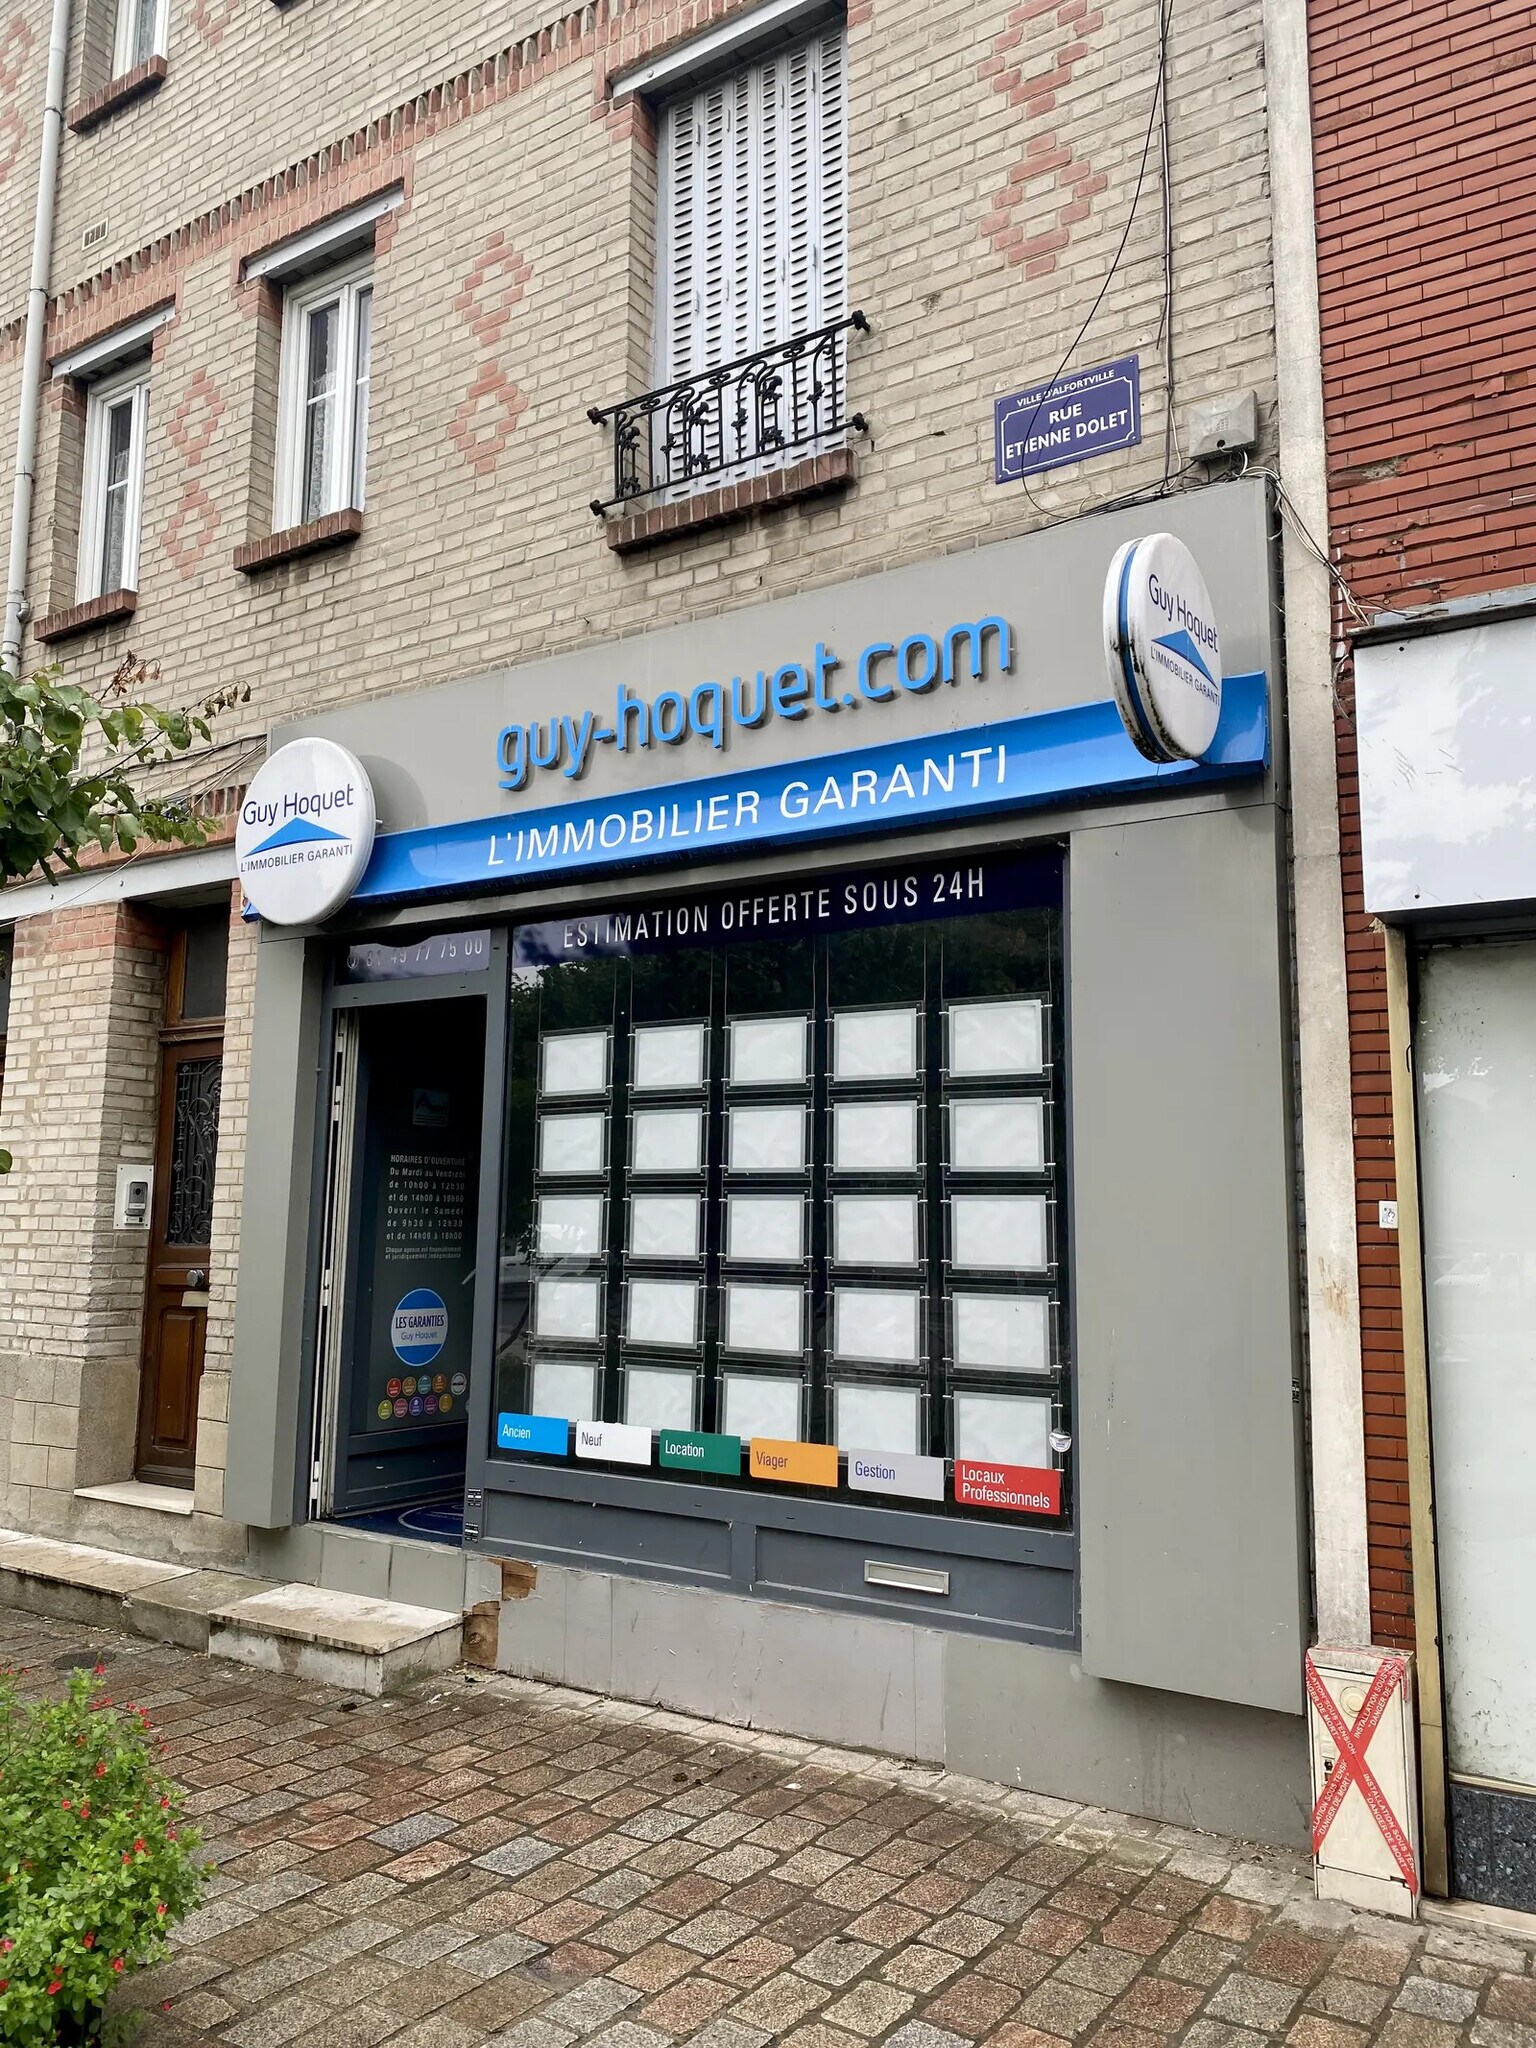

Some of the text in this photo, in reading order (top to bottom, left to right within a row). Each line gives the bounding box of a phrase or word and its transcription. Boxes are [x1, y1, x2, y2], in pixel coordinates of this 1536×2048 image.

[1017, 369, 1115, 407] VILLE D'ALFORTVILLE
[1049, 403, 1082, 424] RUE
[1005, 409, 1128, 459] ETIENNE DOLET
[1148, 573, 1219, 654] Guy Hoquet
[1150, 646, 1220, 706] L'IMMOBILIER GARANTI
[496, 614, 1011, 791] guy-hoquet.com
[243, 783, 354, 827] Guy Hoquet
[487, 744, 1008, 867] L'IMMOBILIER GARANTI
[240, 844, 353, 873] L'IMMOBILIER GARANTI
[563, 867, 985, 949] ESTIMATION OFFERTE SOUS 24H
[440, 941, 457, 959] 75
[464, 938, 483, 956] 00
[390, 1154, 423, 1165] HORAIRES
[390, 1167, 400, 1176] Du
[402, 1168, 423, 1177] Mardi
[389, 1180, 399, 1189] de
[404, 1181, 429, 1190] 10h00
[388, 1194, 396, 1202] et
[399, 1193, 408, 1202] de
[411, 1194, 433, 1203] 14h00
[387, 1206, 417, 1215] Ouvert
[434, 1206, 464, 1215] Samedi
[386, 1219, 398, 1228] de
[402, 1219, 424, 1228] 9h30
[386, 1232, 394, 1241] et
[396, 1232, 406, 1241] de
[409, 1232, 431, 1241] 14h00
[395, 1314, 445, 1329] LES GARANTIES
[400, 1330, 438, 1342] Guy Hoquet
[502, 1423, 531, 1440] Ancien
[581, 1431, 603, 1447] Neuf
[665, 1439, 705, 1459] Location
[756, 1451, 788, 1469] Viager
[854, 1461, 896, 1481] Gestion
[962, 1467, 1005, 1486] Locaux
[962, 1483, 1051, 1510] Professionnels
[1384, 1686, 1393, 1698] DE
[1316, 1702, 1326, 1714] DE
[1353, 1691, 1379, 1740] INSTALLATION
[1375, 1672, 1388, 1693] SOUS
[1336, 1721, 1358, 1756] TENSION
[1324, 1783, 1338, 1802] SOUS
[1332, 1795, 1342, 1807] DE
[1362, 1773, 1396, 1828] INSTALLATION
[1392, 1828, 1408, 1852] SOUS
[1384, 1830, 1395, 1844] DE
